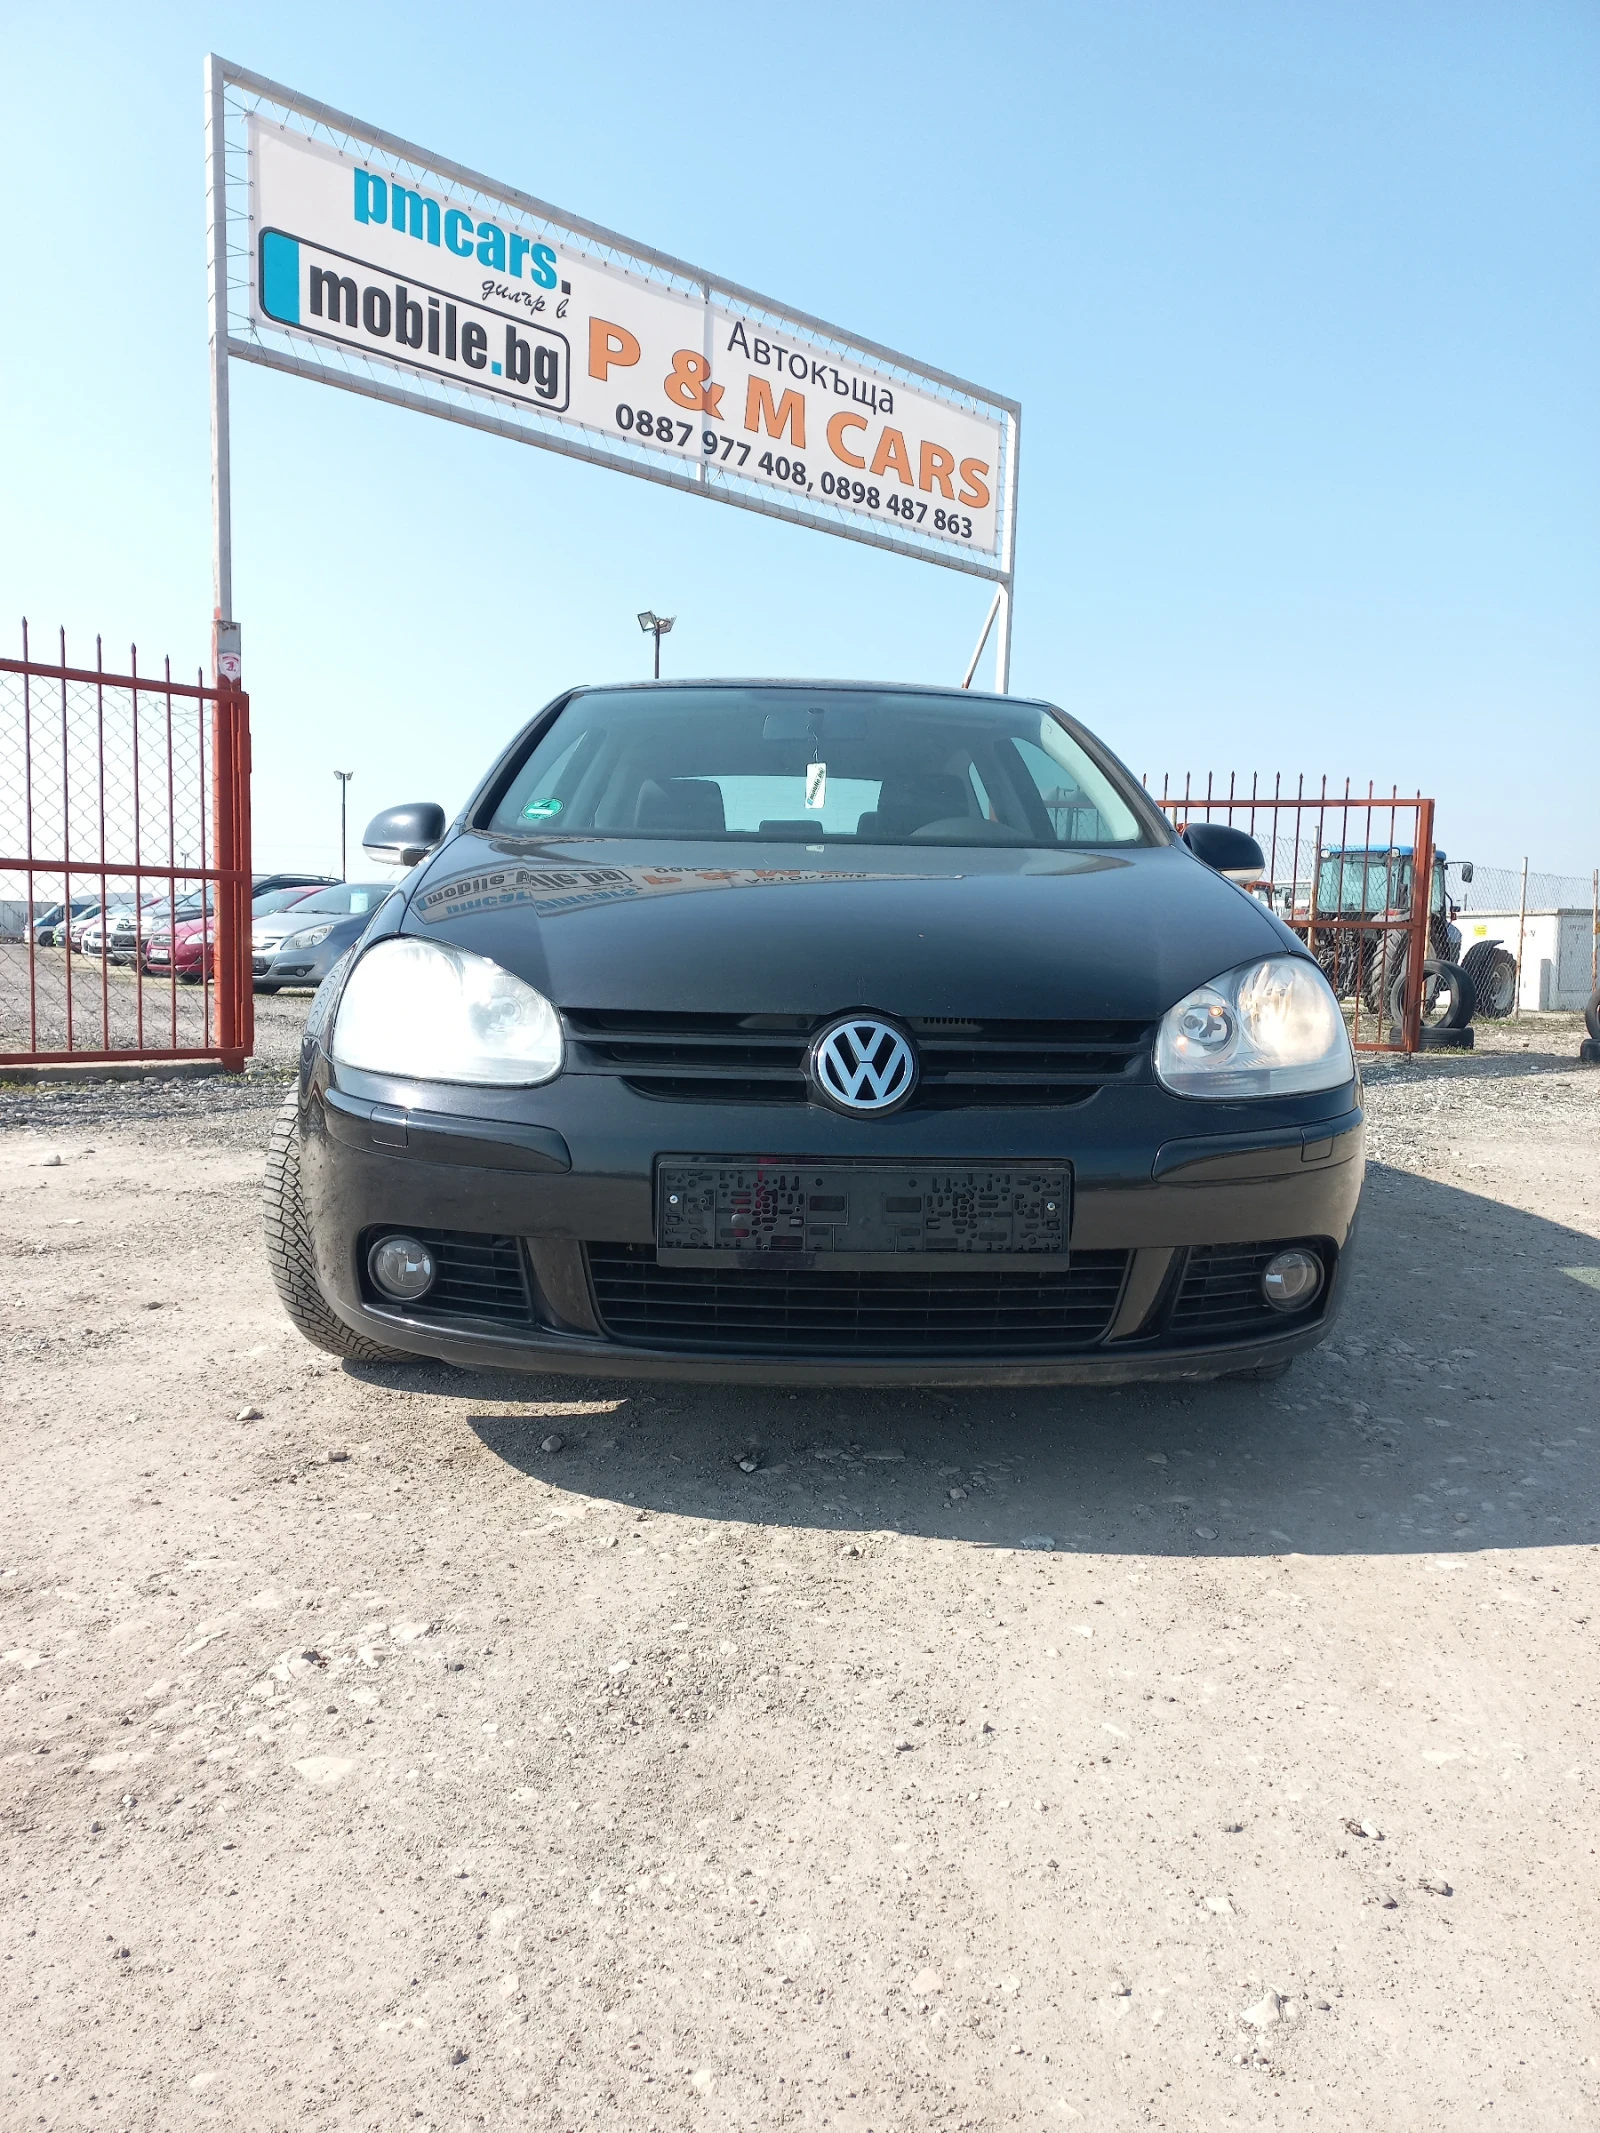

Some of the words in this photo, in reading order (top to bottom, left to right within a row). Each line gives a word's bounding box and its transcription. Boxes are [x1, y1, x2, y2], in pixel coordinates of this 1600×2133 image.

[310, 265, 558, 399] mobile.bg
[727, 321, 894, 415] Автокъща
[588, 316, 641, 382] P
[663, 348, 725, 421] &
[744, 373, 807, 449] M
[826, 411, 990, 509] CARS
[615, 403, 694, 447] 0887
[701, 430, 752, 467] 977
[757, 451, 813, 492] 408,
[820, 471, 880, 510] 0898
[886, 493, 928, 524] 487
[933, 508, 973, 539] 863
